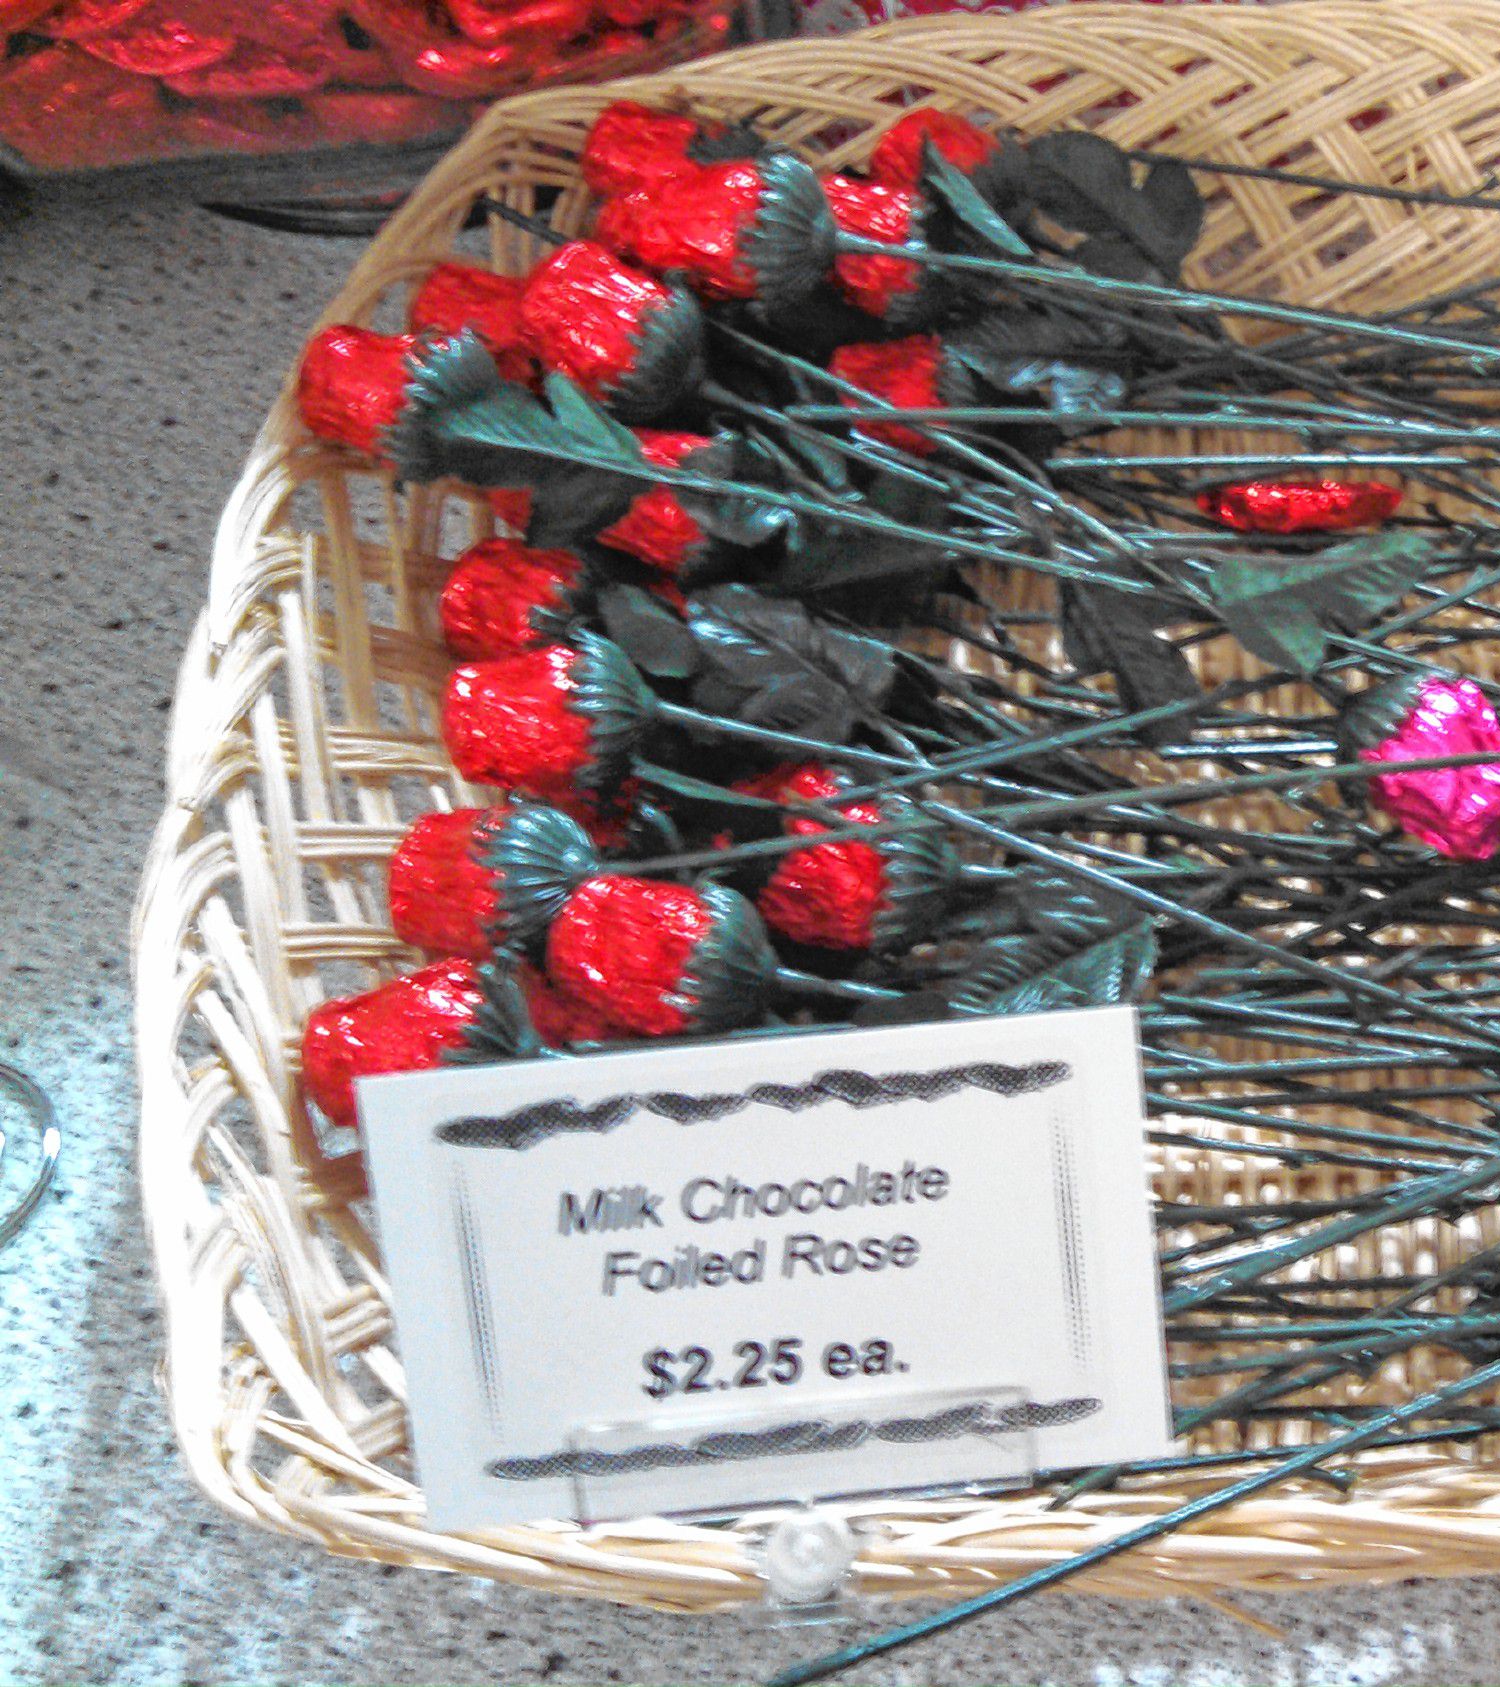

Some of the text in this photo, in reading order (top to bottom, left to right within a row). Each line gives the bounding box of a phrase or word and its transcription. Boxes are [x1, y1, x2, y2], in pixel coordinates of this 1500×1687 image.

[557, 1160, 950, 1236] Milk Chocolate
[602, 1229, 921, 1297] Foiled Rose
[641, 1336, 911, 1400] $2.25 ea.
